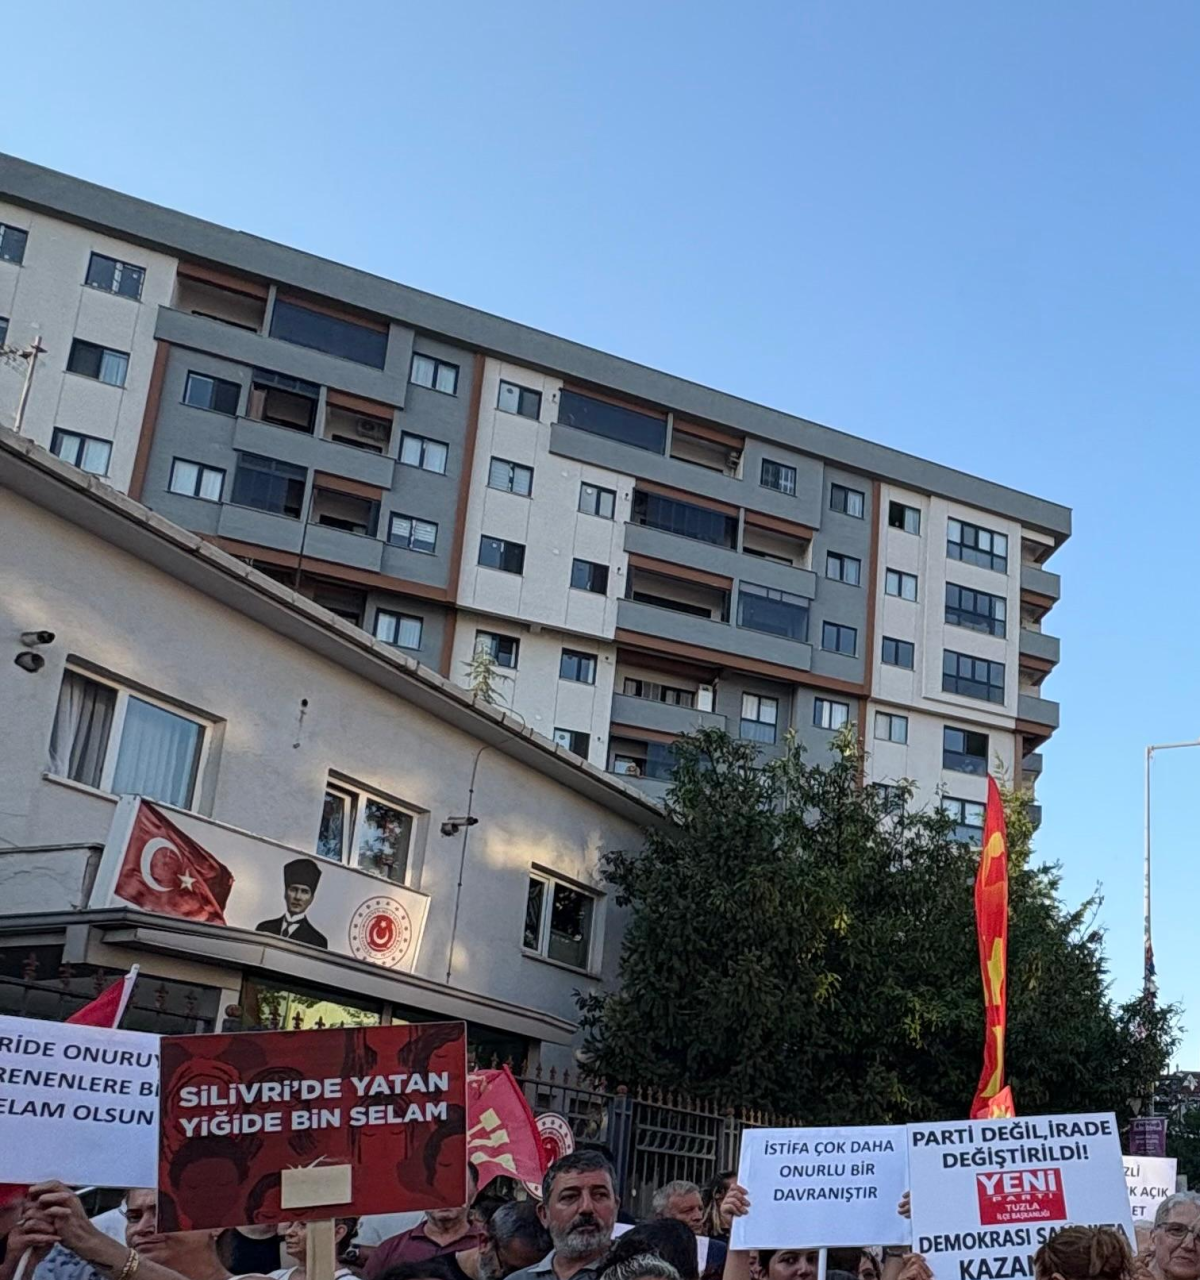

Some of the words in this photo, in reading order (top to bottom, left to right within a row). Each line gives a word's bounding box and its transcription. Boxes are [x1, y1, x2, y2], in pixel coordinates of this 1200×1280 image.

[350, 1072, 449, 1097] YATAN
[73, 1105, 155, 1126] OLSUN
[349, 1102, 448, 1126] SELAM
[912, 1125, 974, 1147] PARTİ
[764, 1140, 809, 1155] İSTİFA
[814, 1141, 846, 1157] ÇOK
[850, 1140, 894, 1154] DAHA
[942, 1141, 1089, 1169] DEĞİŞTİRİLDİ!
[779, 1164, 846, 1178] ONURLU
[851, 1160, 875, 1176] BİR
[773, 1186, 878, 1203] DAVRANIŞTIR
[1005, 1202, 1040, 1211] TUZLA
[919, 1228, 1031, 1254] DEMOKRASI
